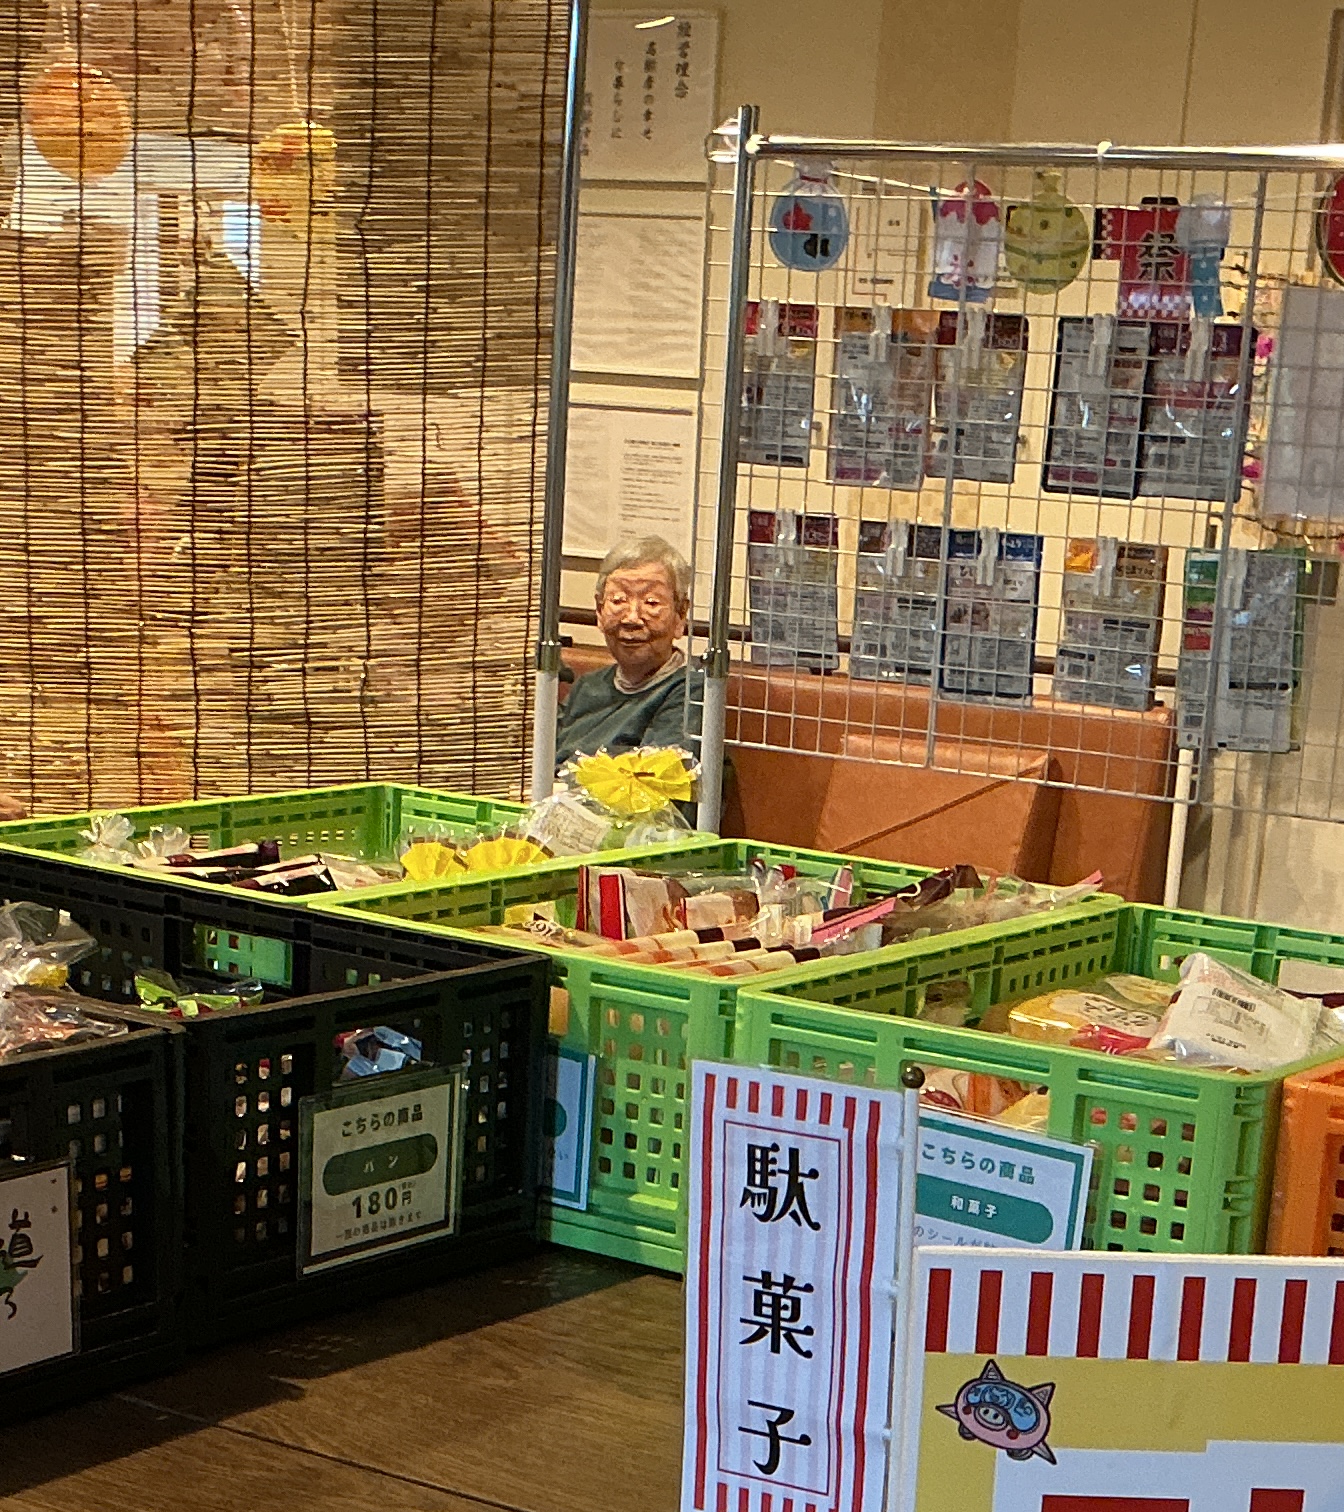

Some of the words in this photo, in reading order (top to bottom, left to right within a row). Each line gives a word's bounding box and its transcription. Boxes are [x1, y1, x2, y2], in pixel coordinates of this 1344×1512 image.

[1137, 231, 1182, 281] 祭
[341, 1103, 424, 1138] こちらの商品
[921, 1142, 1036, 1186] こちらの商品
[950, 1194, 998, 1219] 和菓子
[737, 1142, 821, 1476] 駄菓子
